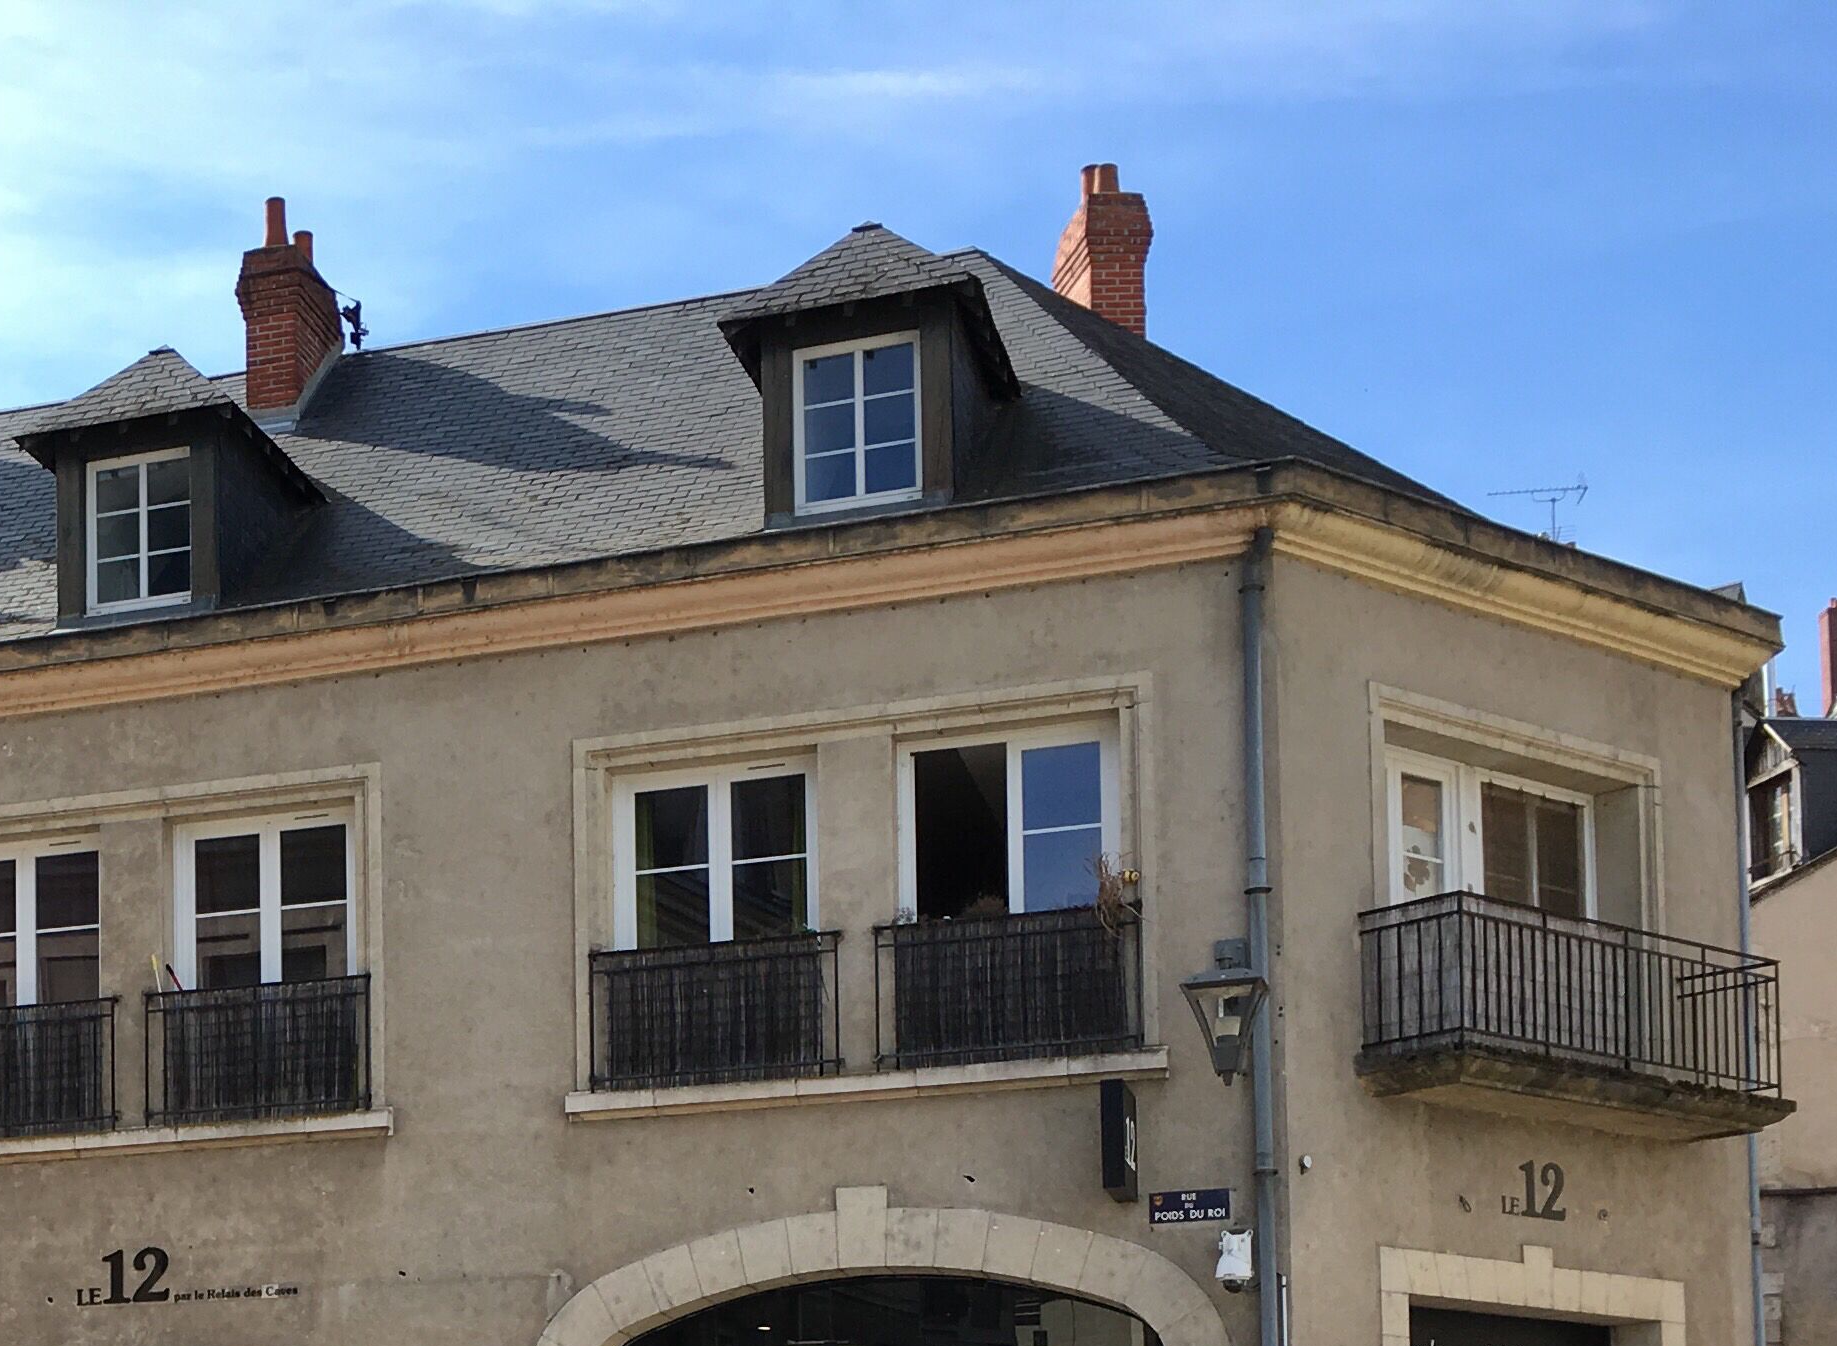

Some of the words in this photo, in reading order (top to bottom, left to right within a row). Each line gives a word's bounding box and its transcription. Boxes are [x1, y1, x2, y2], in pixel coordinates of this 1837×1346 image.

[1181, 1193, 1197, 1201] RUE
[1501, 1195, 1520, 1216] LE
[1518, 1160, 1566, 1221] 12
[1154, 1210, 1185, 1220] POIDS
[1190, 1209, 1204, 1219] DU
[1207, 1208, 1226, 1218] ROI
[76, 1288, 103, 1306] LE
[101, 1247, 170, 1304] 12
[174, 1292, 191, 1303] par
[194, 1290, 205, 1300] le
[207, 1288, 241, 1300] Relais
[243, 1286, 263, 1298] des
[265, 1285, 298, 1297] Caves
